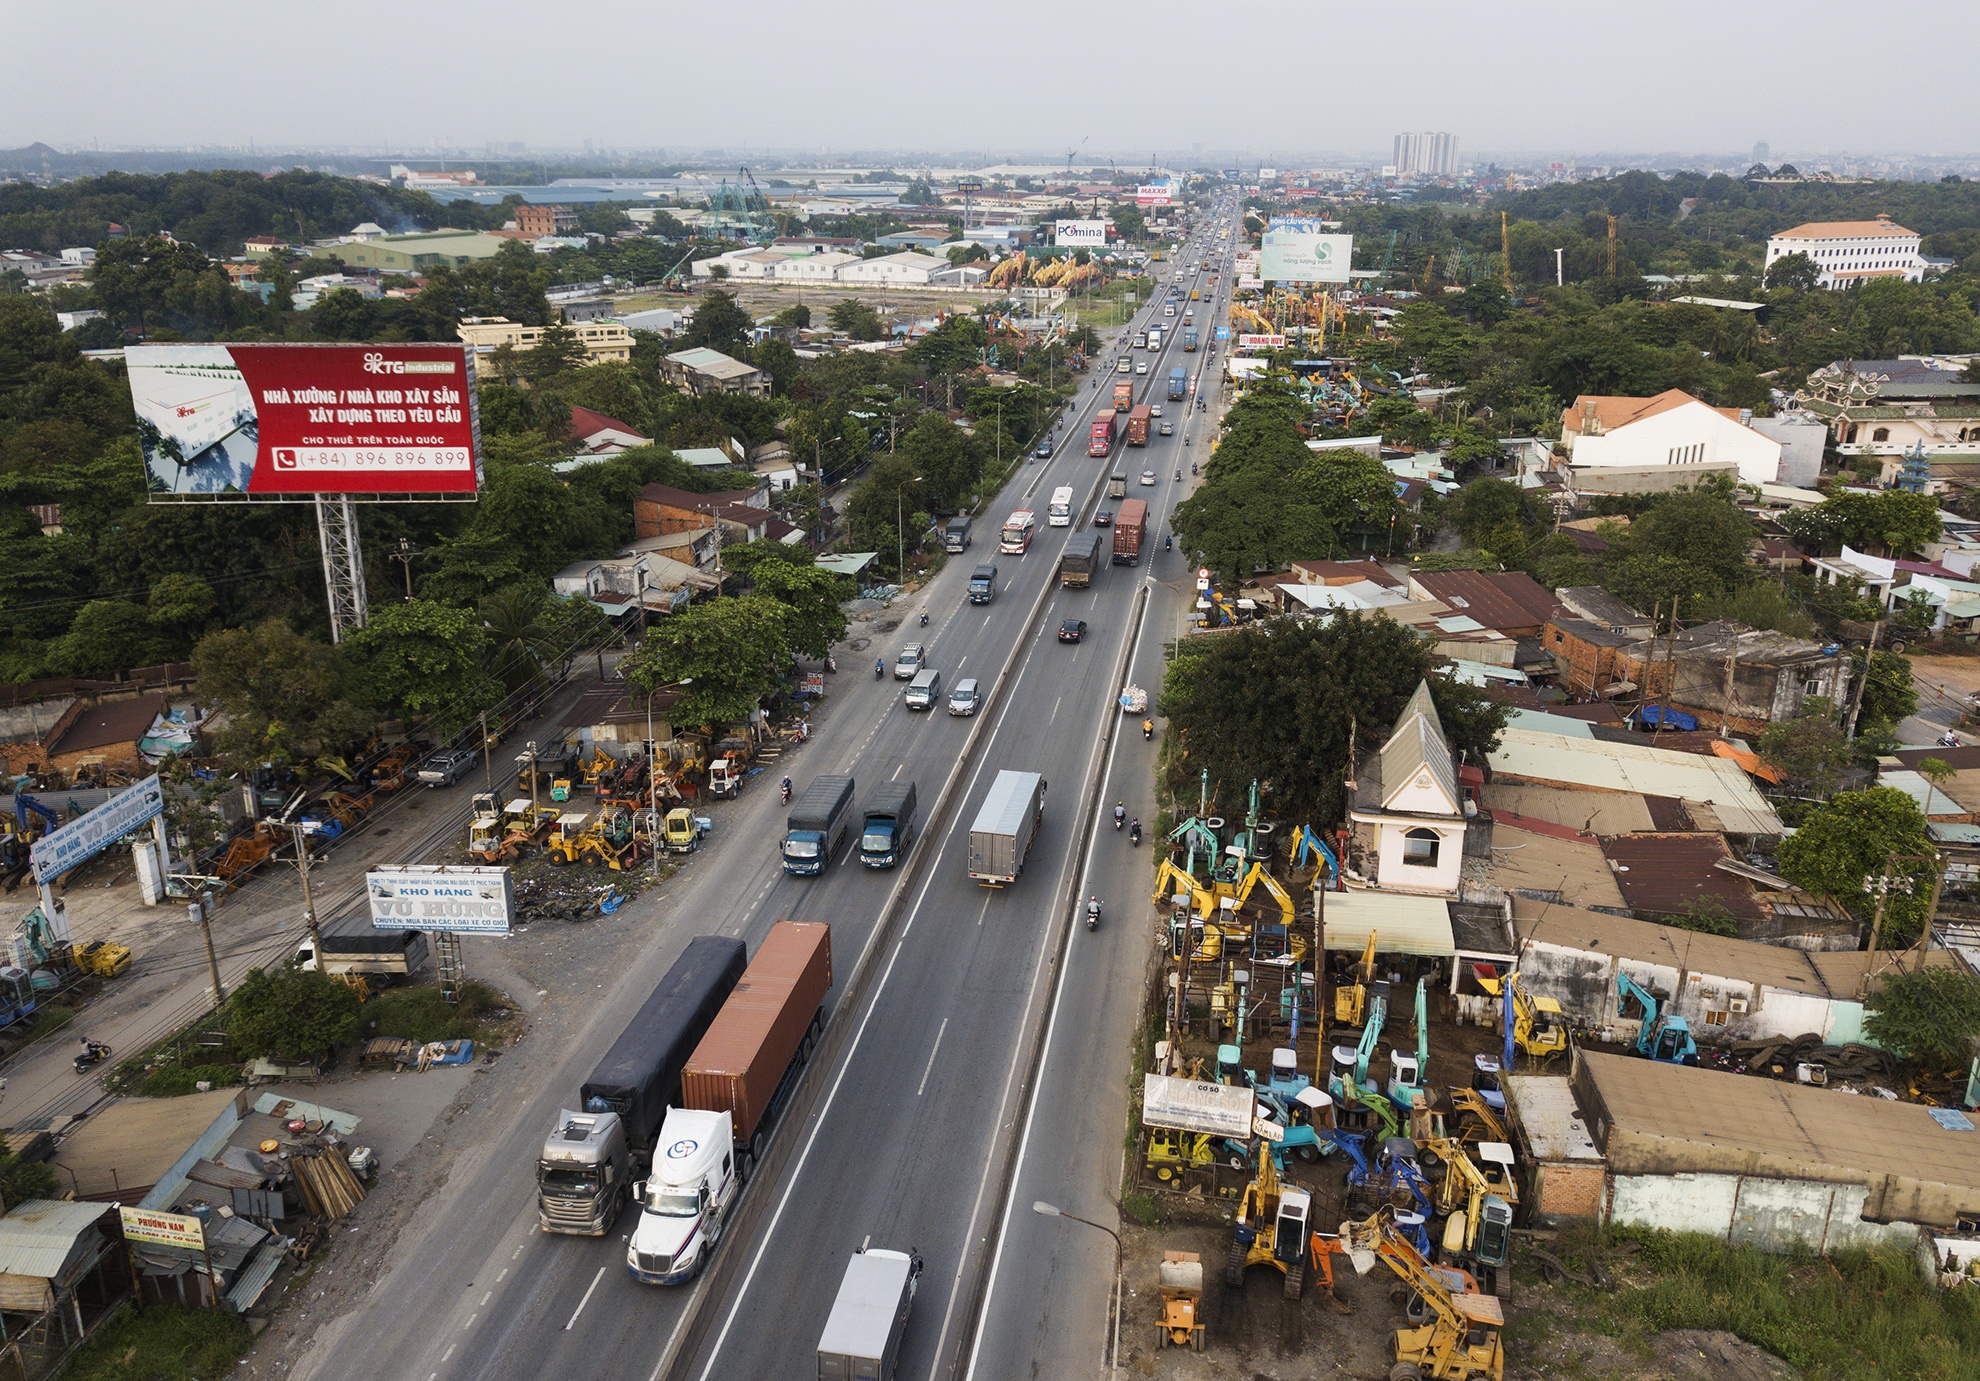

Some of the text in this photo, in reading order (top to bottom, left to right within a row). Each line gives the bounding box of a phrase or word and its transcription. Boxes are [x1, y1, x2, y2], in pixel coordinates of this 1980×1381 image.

[372, 361, 455, 374] KTG Industrial
[263, 387, 291, 404] NHÀ
[292, 386, 337, 404] XƯỞNG
[347, 387, 376, 404] NHÀ
[377, 390, 402, 404] KHO
[404, 387, 430, 404] XÂY
[309, 405, 462, 426] XÂY DỰNG THEO YÊU CẦU
[302, 434, 444, 445] CHO THUÊ TRÊN TOÀN QUỐC
[300, 452, 466, 466] (+84) 896 896 899
[434, 887, 473, 896] HÀNG
[421, 896, 505, 918] HÙNG
[552, 1152, 586, 1160] HYDAI
[138, 1217, 185, 1232] PHƯƠNG NAM
